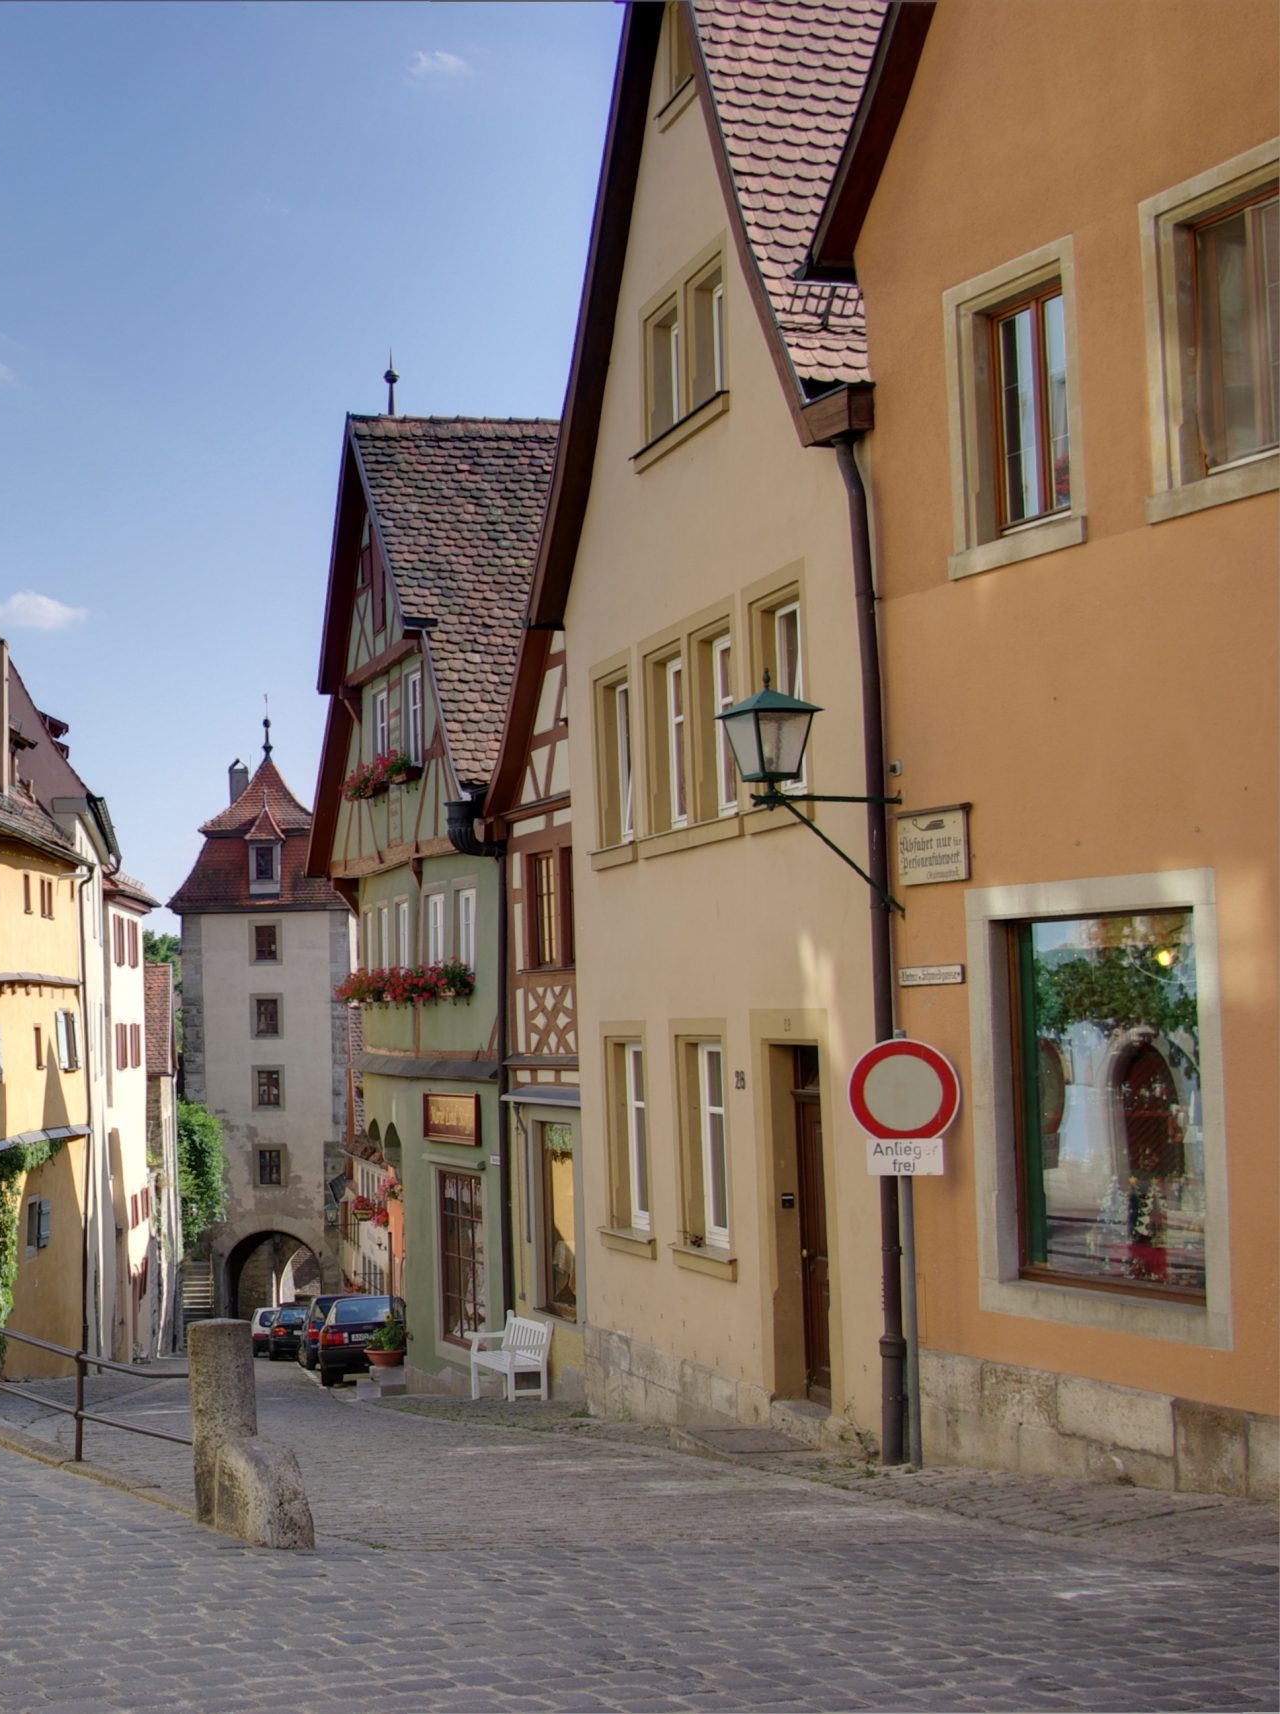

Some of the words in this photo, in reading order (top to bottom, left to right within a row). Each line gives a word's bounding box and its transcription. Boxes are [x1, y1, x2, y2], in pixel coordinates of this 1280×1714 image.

[936, 836, 952, 848] nur
[873, 1141, 938, 1159] Anlieg
[892, 1158, 916, 1173] frei
